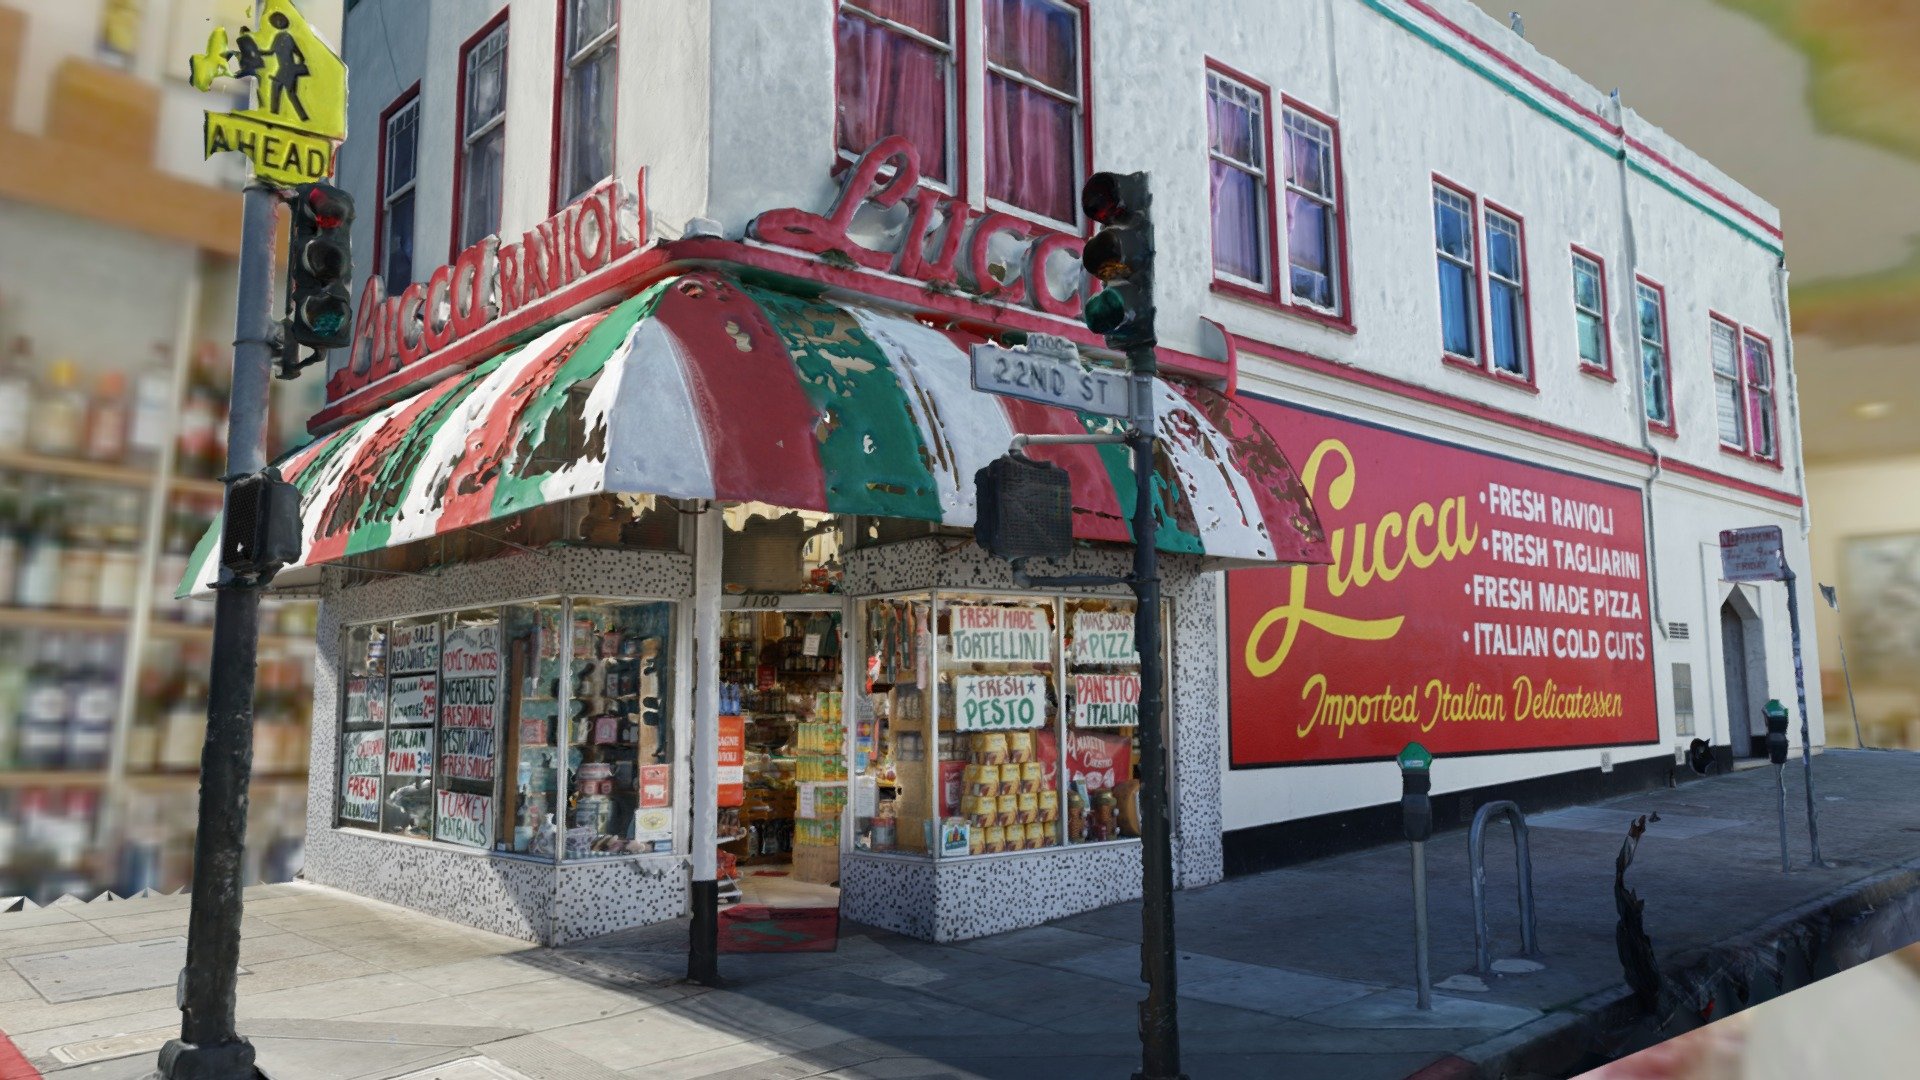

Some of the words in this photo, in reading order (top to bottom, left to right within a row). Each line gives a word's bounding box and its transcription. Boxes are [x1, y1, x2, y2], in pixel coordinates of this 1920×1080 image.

[210, 125, 325, 178] AHEAD
[499, 165, 649, 316] RAVIOLI
[993, 357, 1066, 397] 22ND
[1080, 374, 1108, 404] ST
[1489, 483, 1546, 522] FRESH
[1552, 497, 1614, 535] RAVIOLI
[1738, 531, 1778, 545] PARKING
[1245, 439, 1478, 678] Lucca
[1492, 530, 1548, 567] FRESH
[1553, 539, 1641, 579] TAGLIARINI
[1735, 561, 1767, 571] FRIDAY
[741, 595, 781, 607] 1100
[1473, 575, 1533, 611] FRESH
[1540, 582, 1589, 615] MADE
[1594, 587, 1642, 619] PIZZA
[959, 608, 999, 629] FRESH
[1002, 609, 1036, 630] MADE
[1080, 614, 1106, 631] MAKE
[1107, 614, 1133, 631] YOUR
[413, 625, 434, 644] SALE
[953, 630, 1045, 661] TORTELLINI
[1474, 622, 1549, 657] ITALIAN
[1552, 627, 1600, 659] COLD
[1604, 631, 1646, 661] CUTS
[391, 649, 406, 672] RED
[443, 679, 495, 704] MEATBALLS
[977, 676, 1025, 698] FRESH
[442, 705, 467, 727] FRESH
[467, 706, 493, 728] DAILY
[963, 697, 1035, 727] PESTO
[1297, 673, 1419, 739] Imported
[1420, 679, 1507, 733] Italian
[1512, 676, 1623, 721] Delicatessen
[389, 729, 426, 749] ITALIAN
[442, 730, 467, 754] PESTO
[467, 730, 494, 758] WHITE
[389, 752, 416, 773] TUNA
[441, 755, 467, 776] FRESH
[467, 757, 494, 780] SAUCE
[347, 776, 377, 800] FRESH
[341, 799, 361, 818] PIZZA
[439, 791, 489, 823] TURKEY
[438, 816, 487, 847] MEATBALLS
